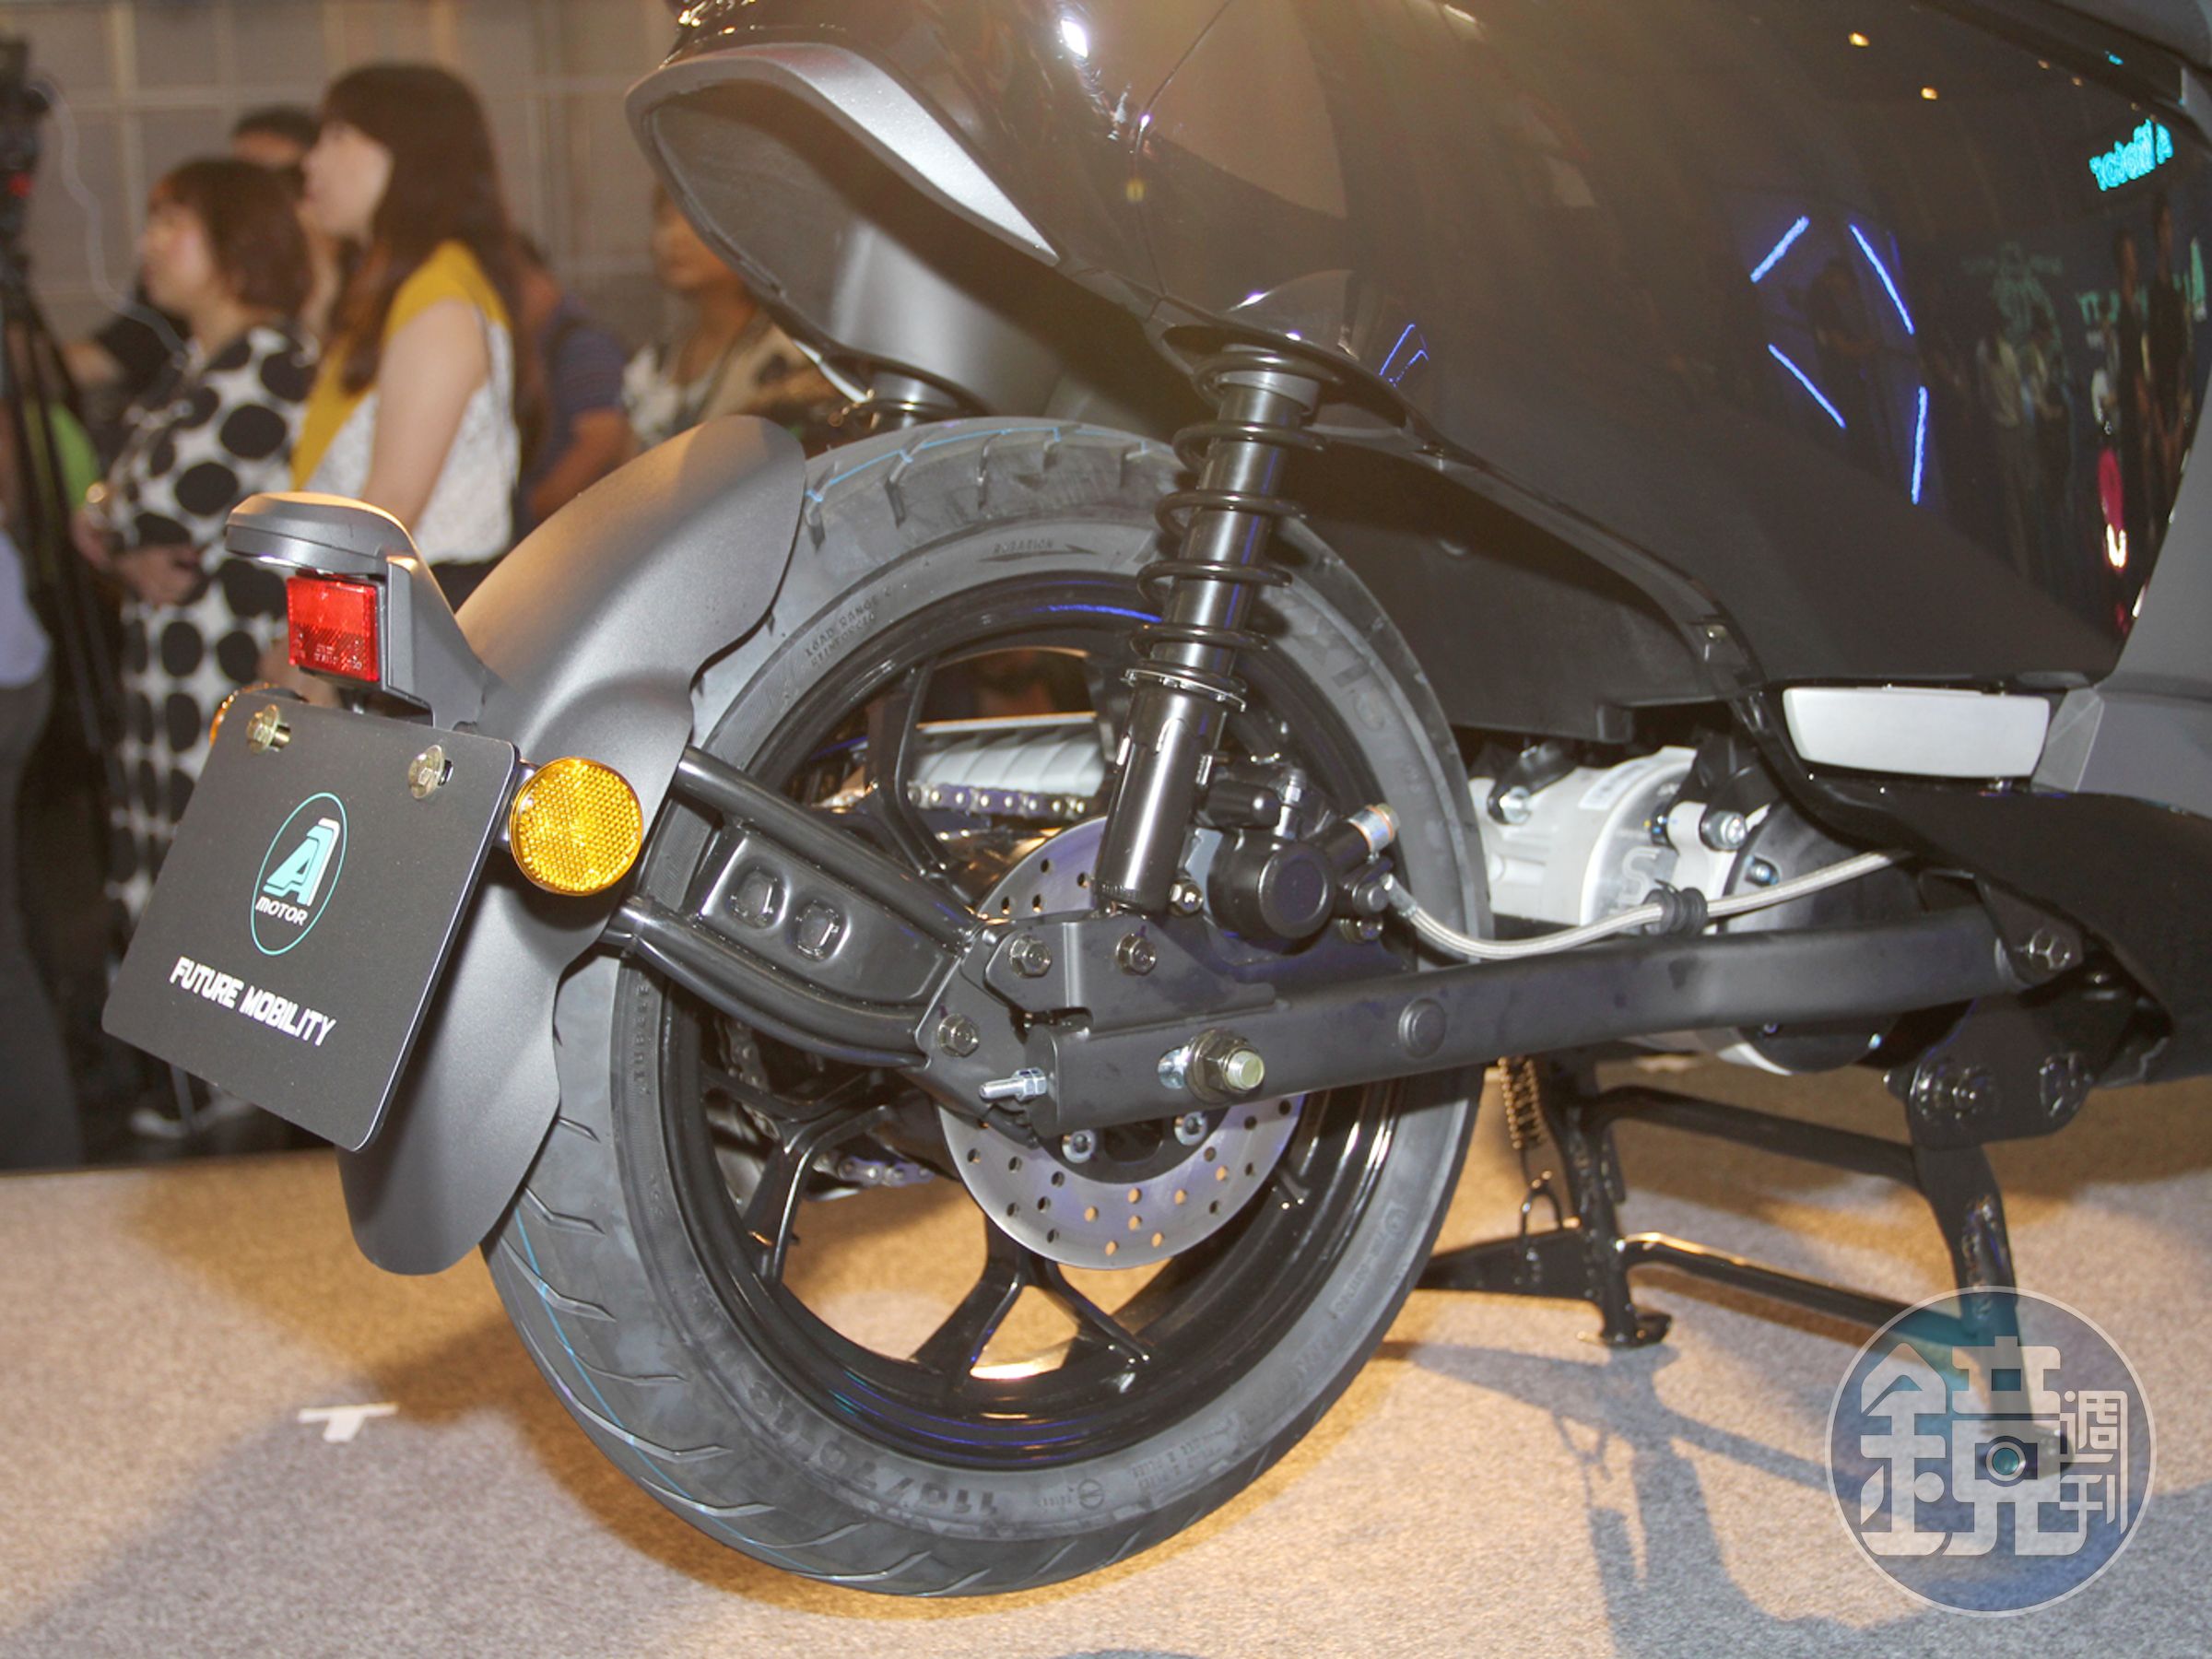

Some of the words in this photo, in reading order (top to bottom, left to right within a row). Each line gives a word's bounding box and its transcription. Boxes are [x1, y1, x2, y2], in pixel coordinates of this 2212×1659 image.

[255, 896, 308, 925] MOTOR
[169, 956, 244, 1008] FUTURE
[240, 986, 336, 1046] MOBILITY
